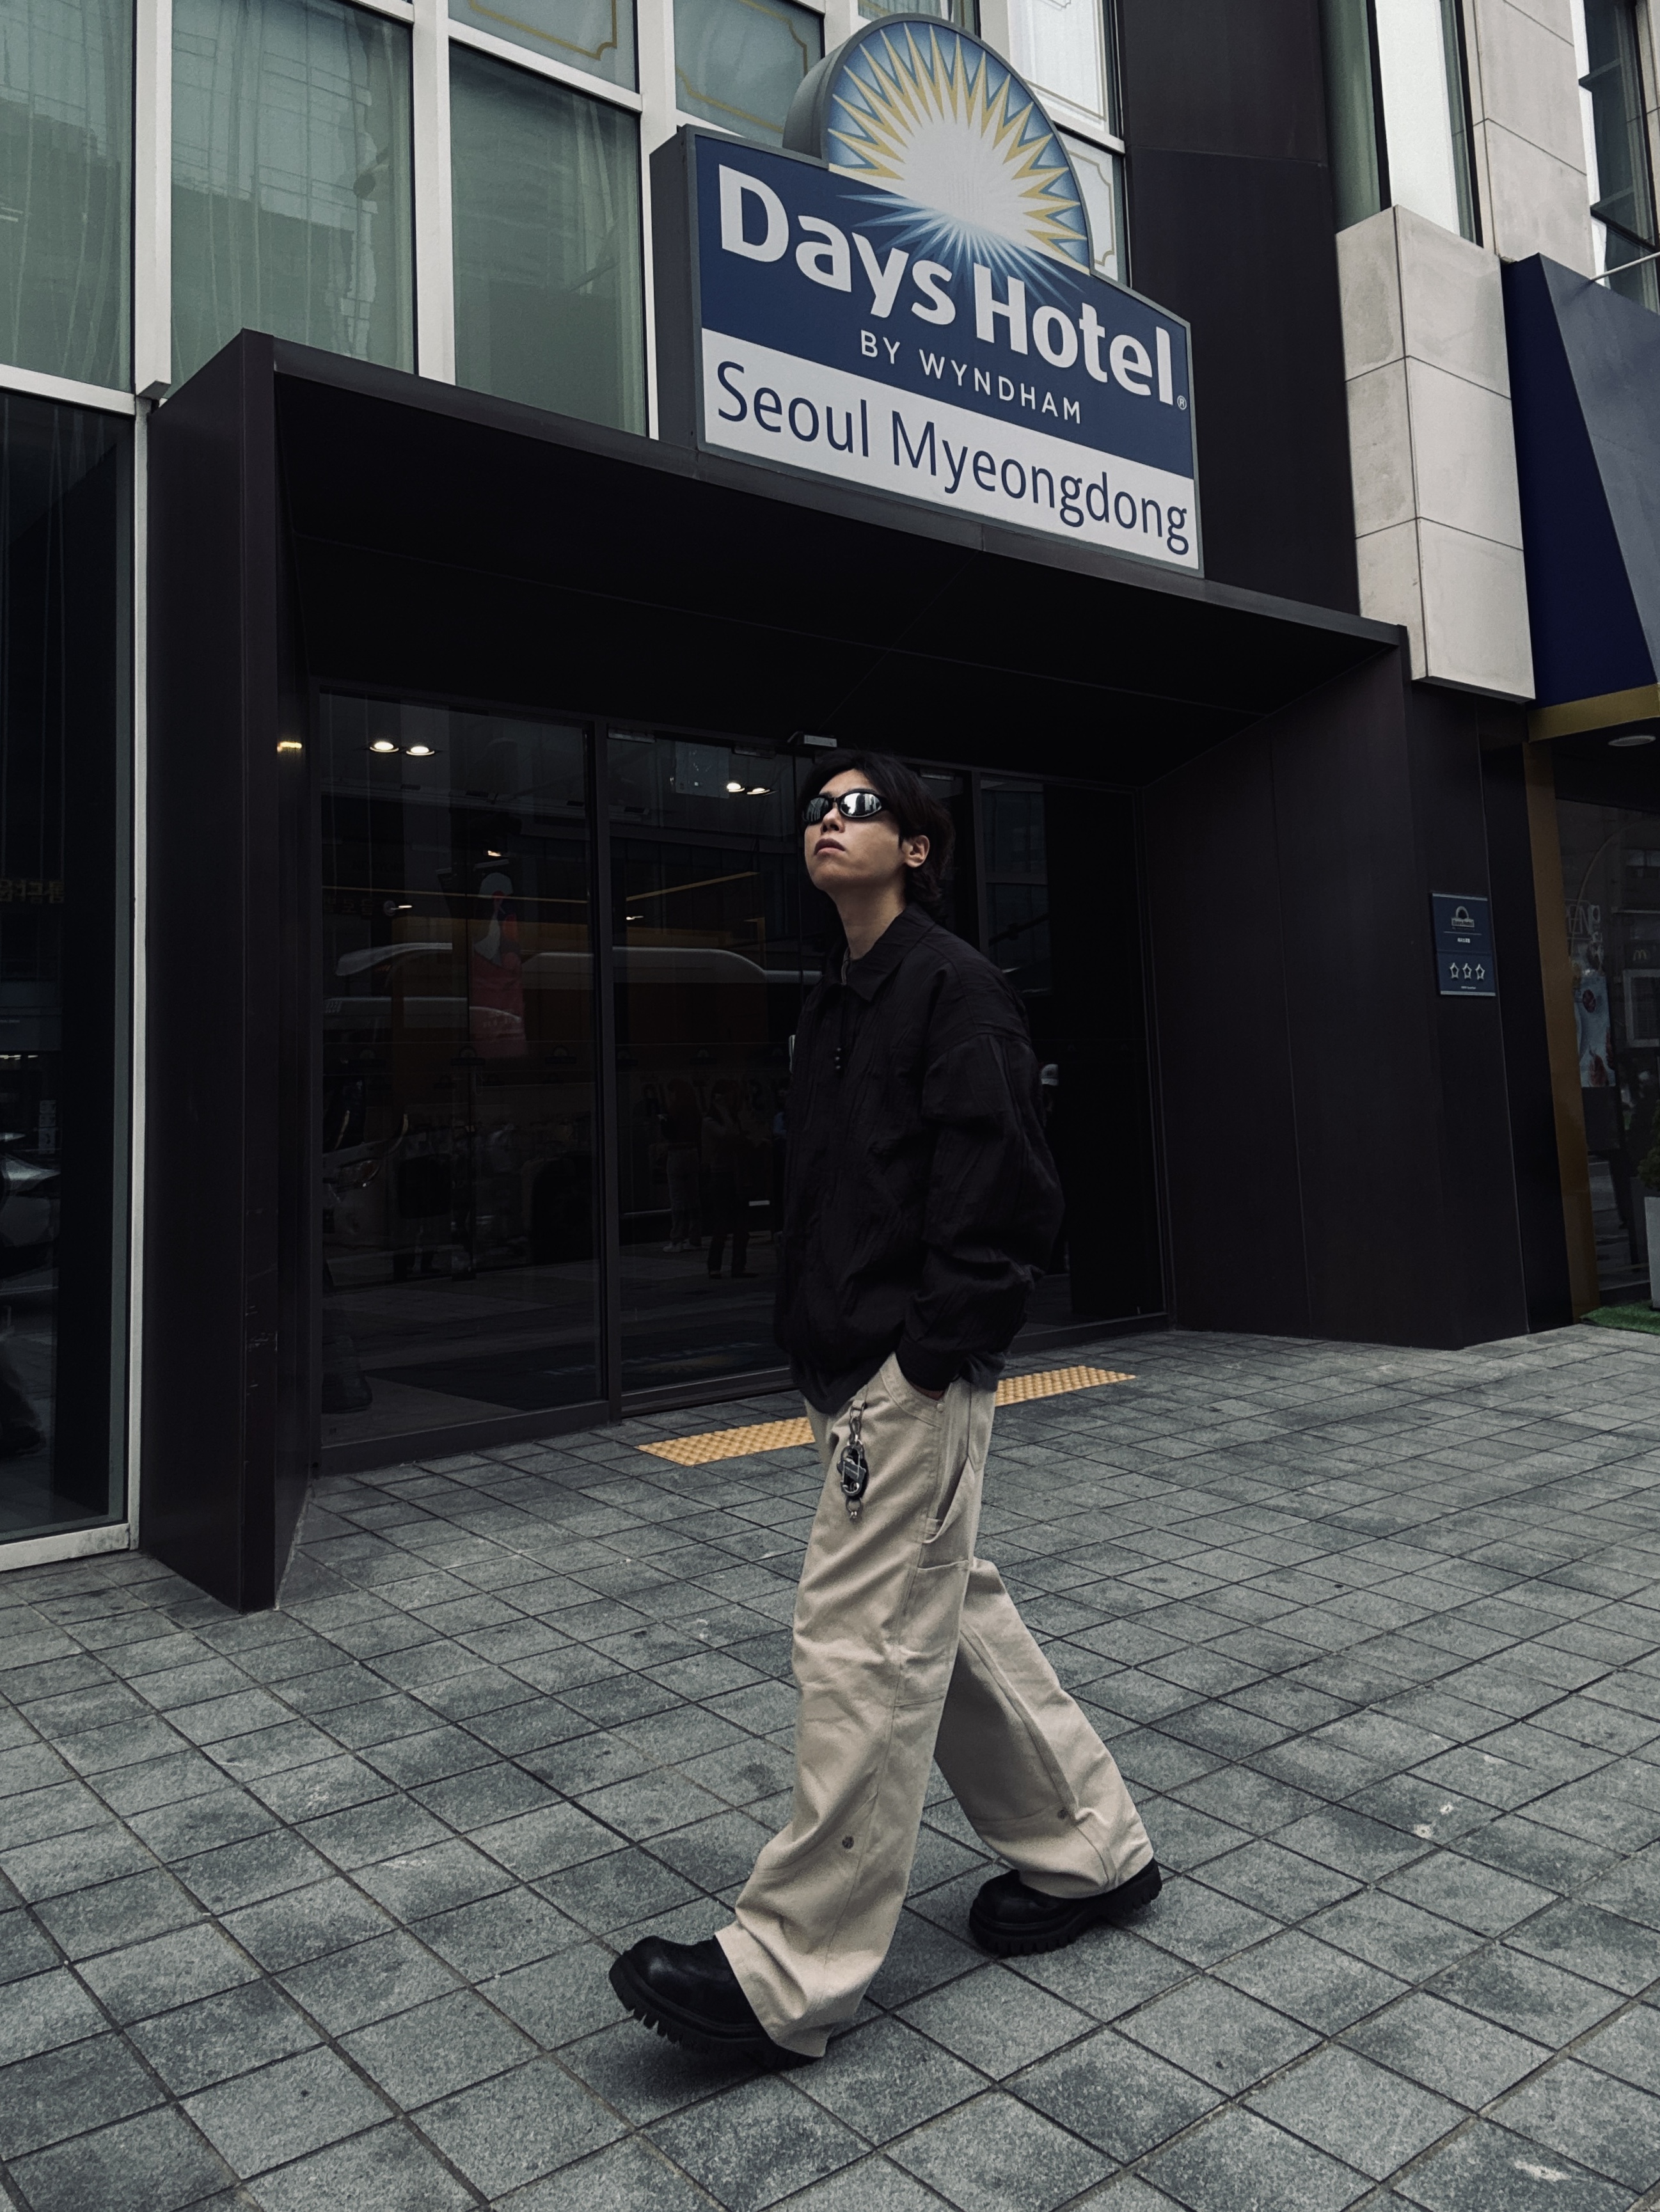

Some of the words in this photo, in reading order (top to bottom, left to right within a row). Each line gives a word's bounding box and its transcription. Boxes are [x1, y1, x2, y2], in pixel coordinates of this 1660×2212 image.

[718, 164, 956, 325] Days
[974, 262, 1174, 406] Hotel
[860, 329, 901, 365] BY
[919, 349, 1081, 425] WYNDHAM
[717, 360, 869, 458] Seoul
[892, 409, 1190, 555] Myeongdong
